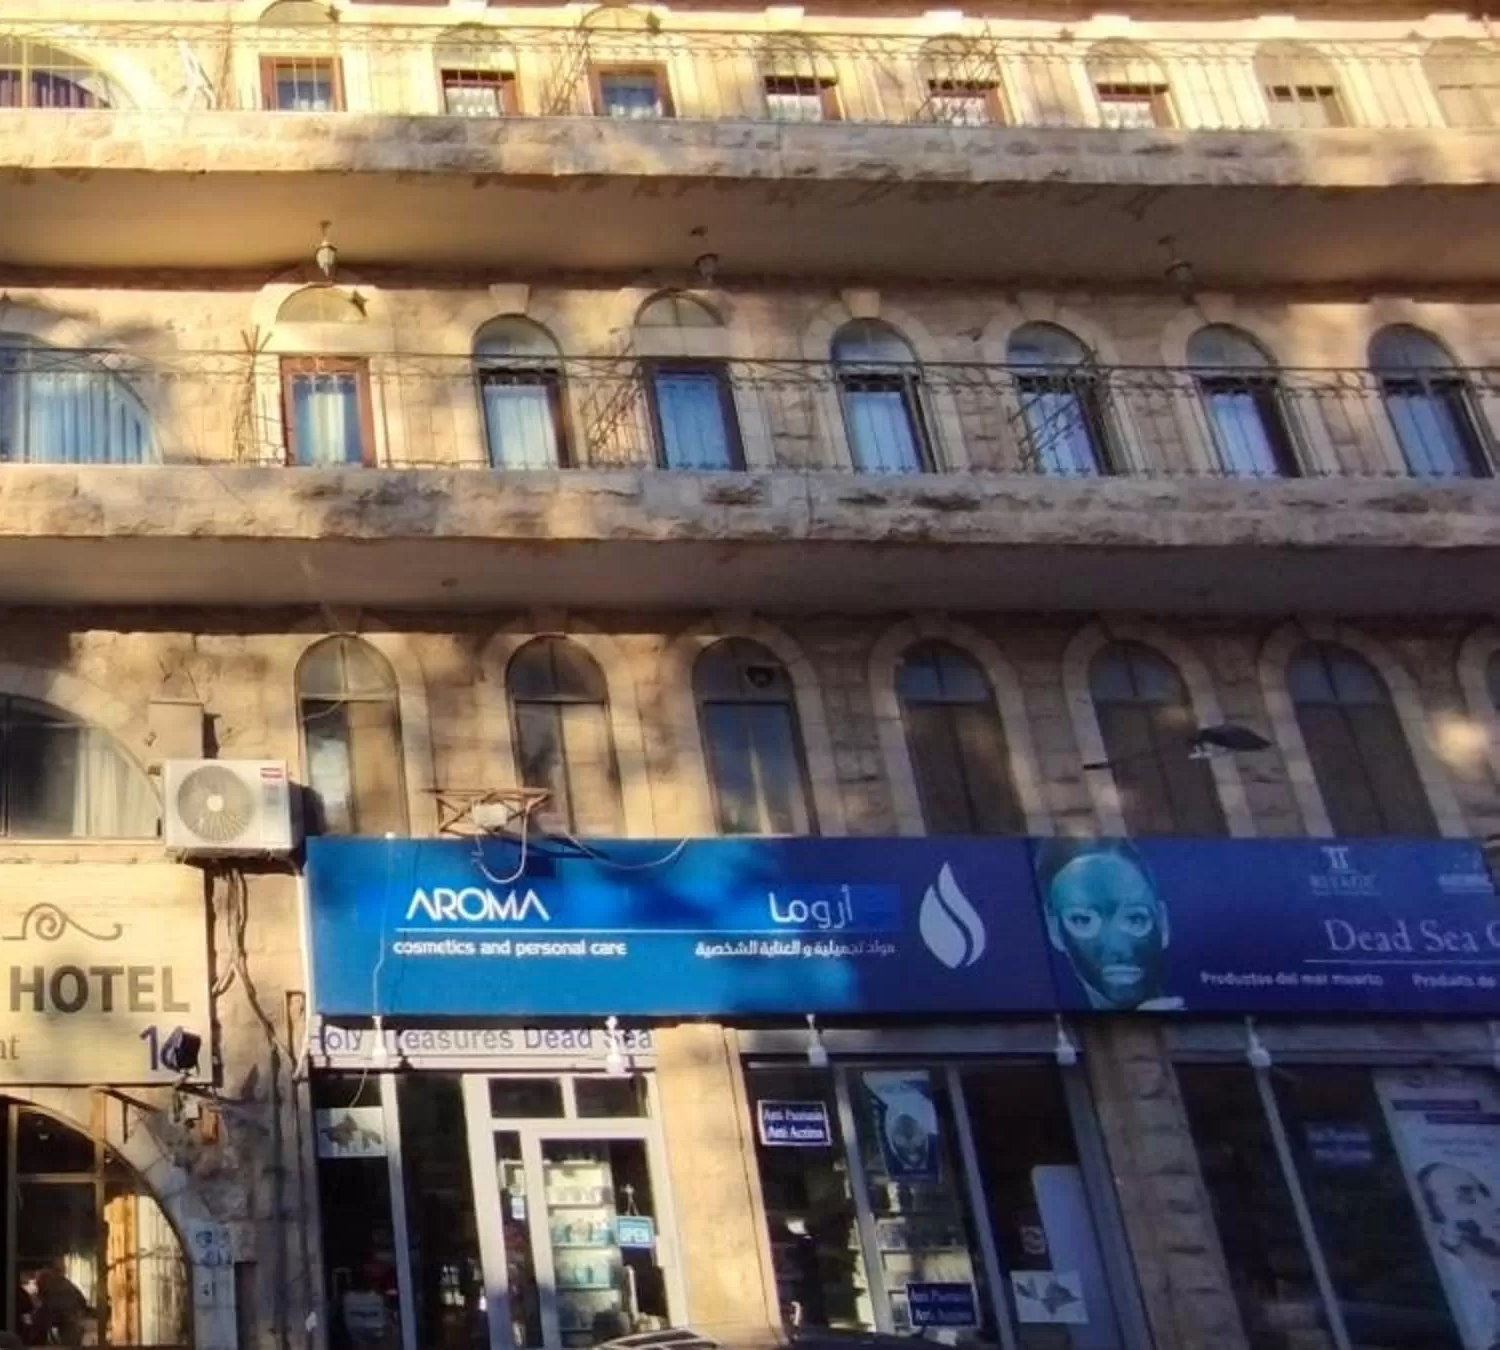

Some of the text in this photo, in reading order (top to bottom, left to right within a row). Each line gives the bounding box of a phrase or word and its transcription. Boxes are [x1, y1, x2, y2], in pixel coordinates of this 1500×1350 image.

[404, 886, 551, 922] AROMA
[767, 884, 853, 930] أروما
[392, 938, 628, 958] cosmetics and personal care
[1323, 918, 1413, 953] Dead
[1418, 918, 1481, 953] Sea
[9, 964, 192, 1014] HOTEL
[523, 1026, 593, 1050] Dead
